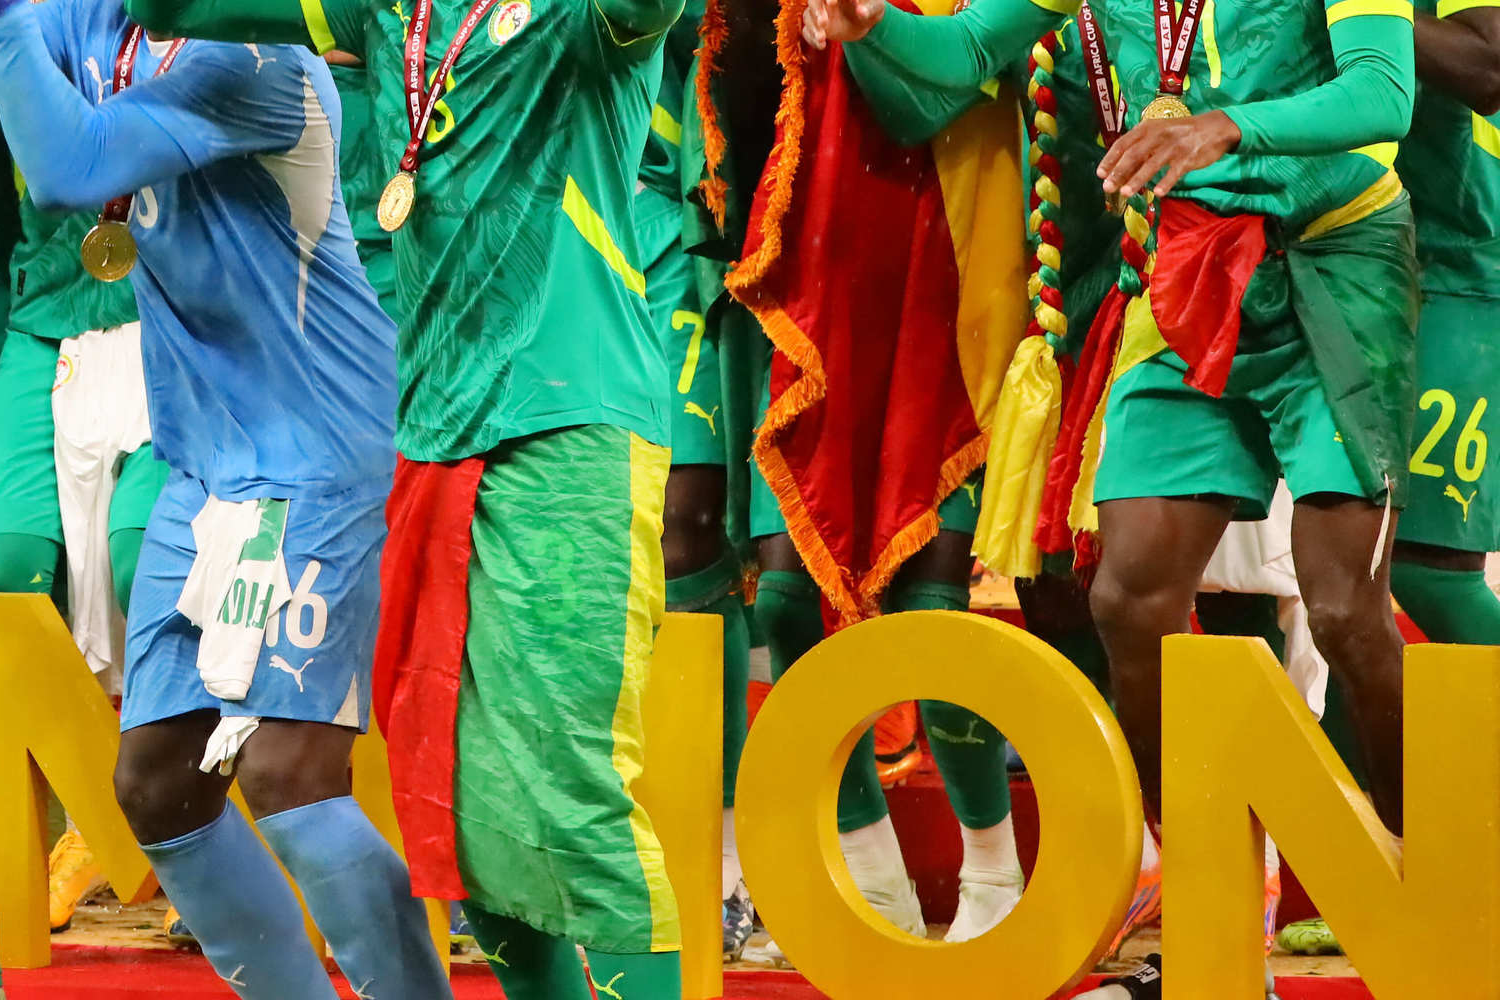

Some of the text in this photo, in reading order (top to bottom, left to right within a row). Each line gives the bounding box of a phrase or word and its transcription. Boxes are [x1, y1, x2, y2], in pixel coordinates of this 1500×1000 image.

[415, 19, 424, 34] OF
[1162, 22, 1172, 51] CAF
[1178, 23, 1192, 52] CAF
[411, 33, 421, 53] CUP
[438, 46, 458, 82] AFRICA
[455, 27, 469, 47] CUP
[467, 13, 479, 29] OF
[1082, 6, 1110, 112] CAF AFRICA CUP OF
[120, 63, 129, 77] OF
[410, 54, 419, 89] AFRICA
[671, 310, 705, 394] 7
[1409, 388, 1488, 482] 26
